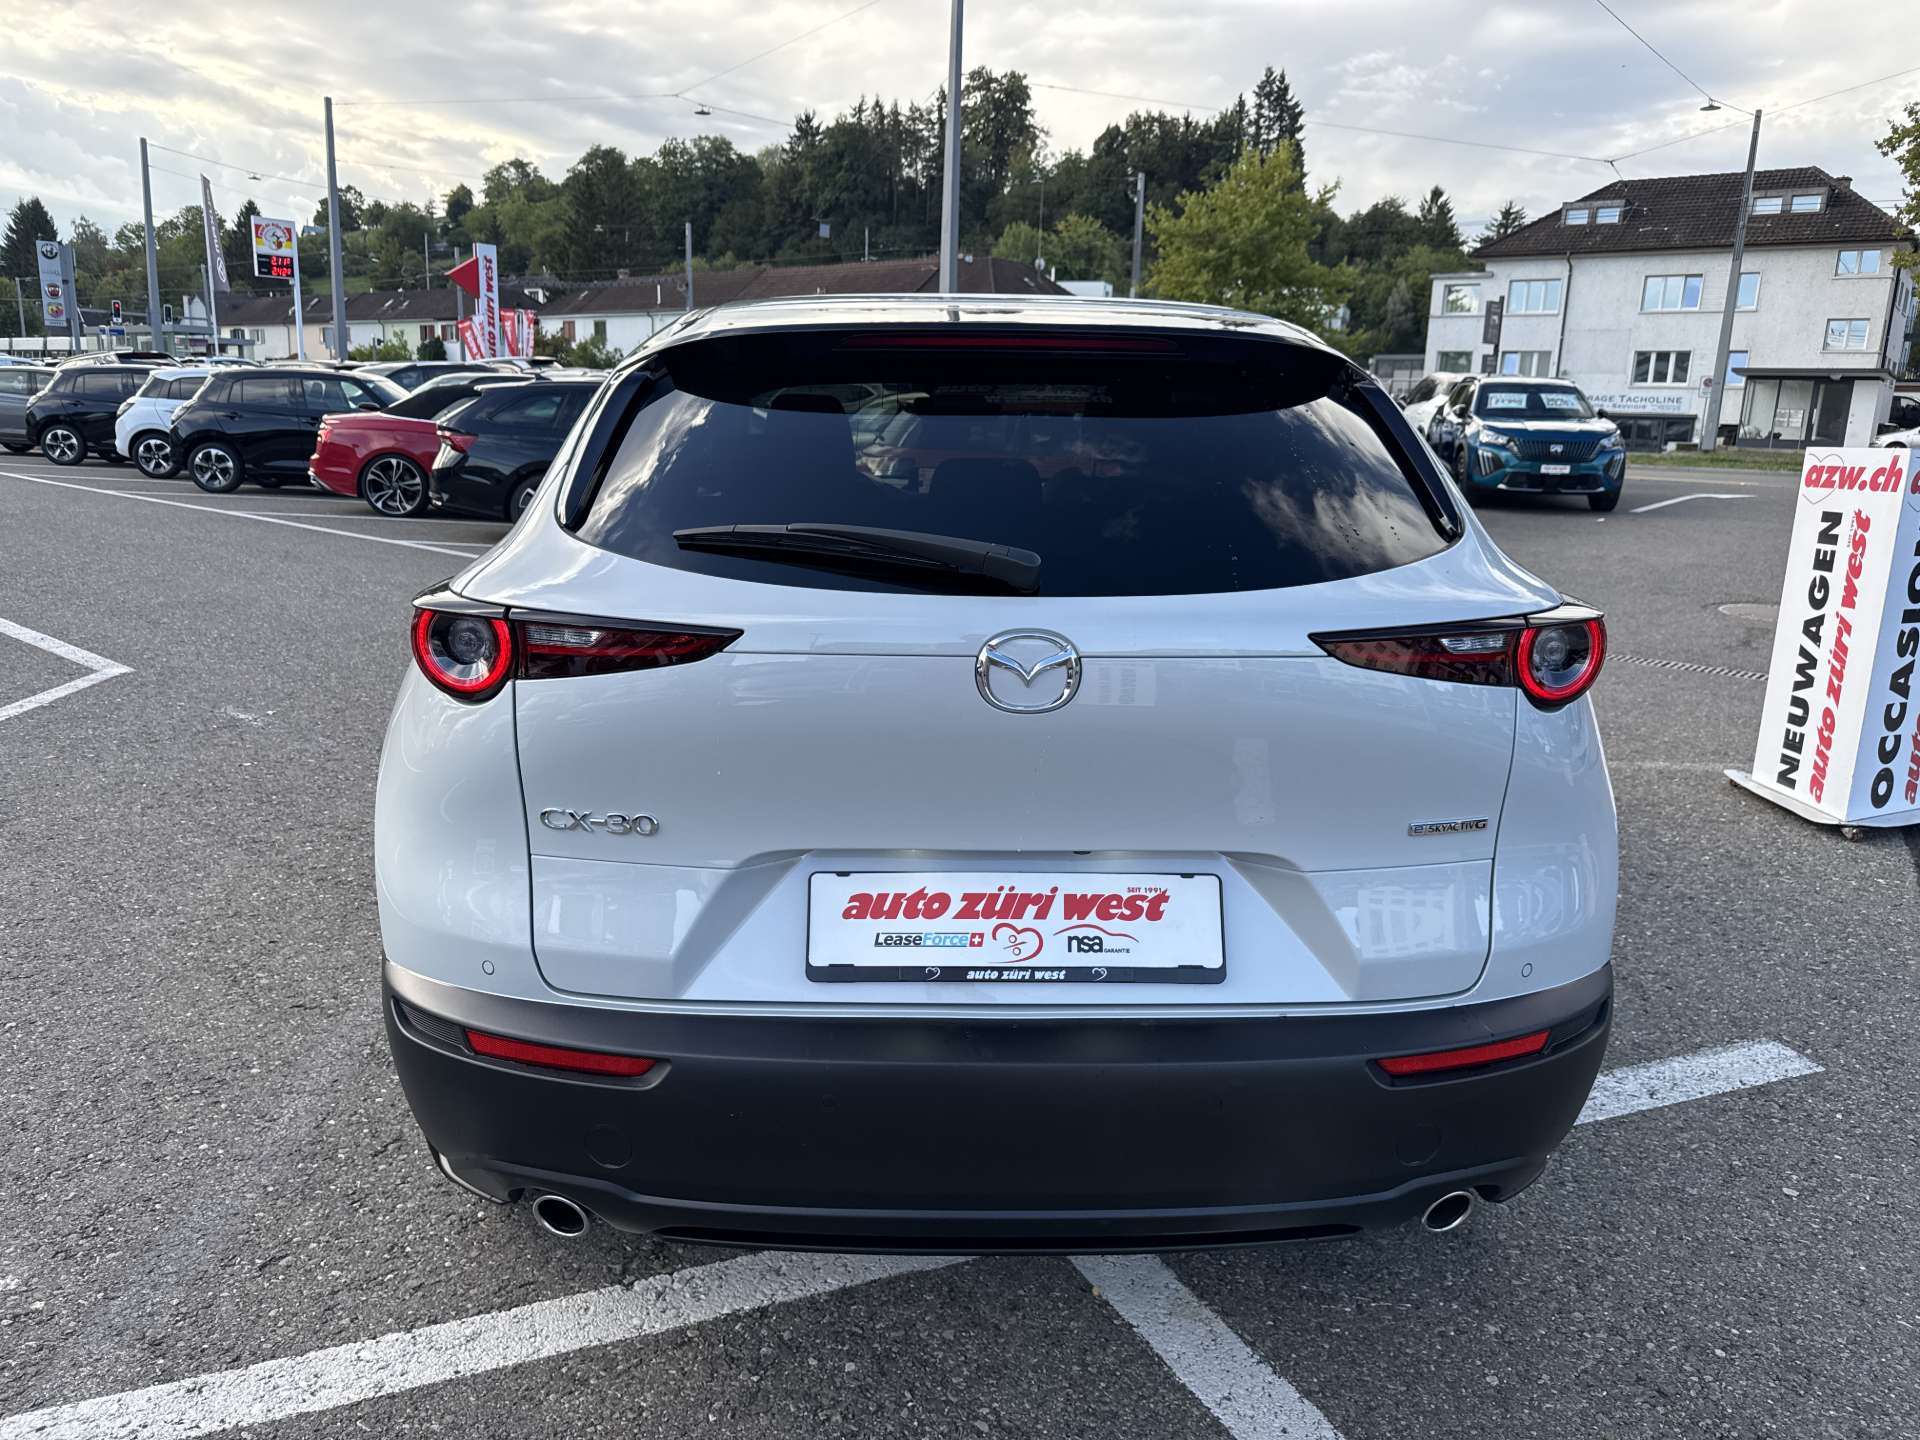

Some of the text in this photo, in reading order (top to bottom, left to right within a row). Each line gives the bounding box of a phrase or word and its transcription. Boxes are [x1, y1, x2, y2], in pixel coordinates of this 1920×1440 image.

[483, 255, 494, 293] west
[1619, 395, 1683, 405] TACHOLINE
[1804, 454, 1904, 493] azw.ch
[1776, 510, 1844, 790] NEUWAGEN
[1809, 508, 1871, 805] auto züri west
[540, 807, 660, 837] CX-30
[841, 885, 1171, 922] auto züri west
[1127, 886, 1162, 894] SEIT 1991
[874, 932, 970, 947] LeaseForce
[1067, 935, 1104, 953] nsa
[966, 968, 1067, 980] auto züri west
